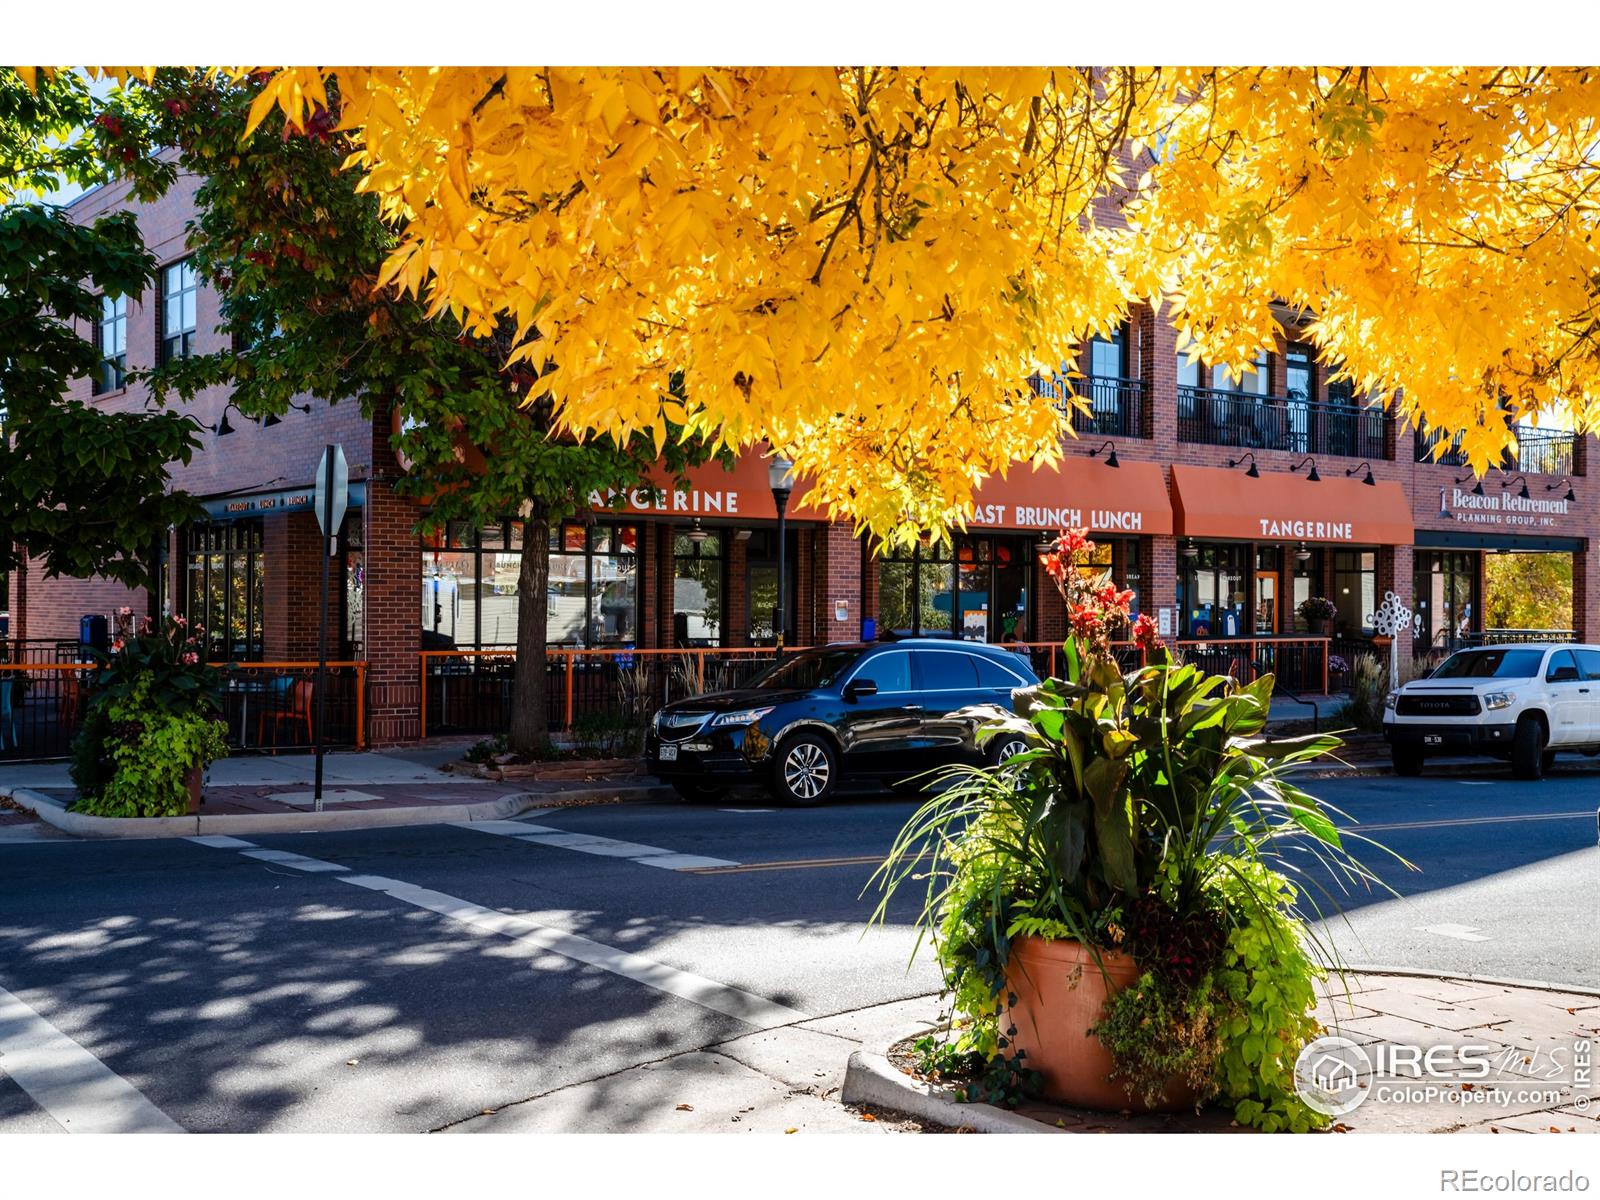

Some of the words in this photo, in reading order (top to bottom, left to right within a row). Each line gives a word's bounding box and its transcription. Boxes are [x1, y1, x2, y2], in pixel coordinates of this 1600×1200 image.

[567, 487, 738, 513] AGERINE
[1453, 488, 1499, 510] Beacon
[1502, 492, 1569, 514] Retirement
[1015, 506, 1081, 527] BRUNCH
[1091, 510, 1142, 530] LUNCH
[1260, 519, 1352, 539] TANGERINE
[1457, 513, 1502, 524] PLANNING
[1506, 516, 1537, 526] GROUP,
[1540, 519, 1558, 527] INC.
